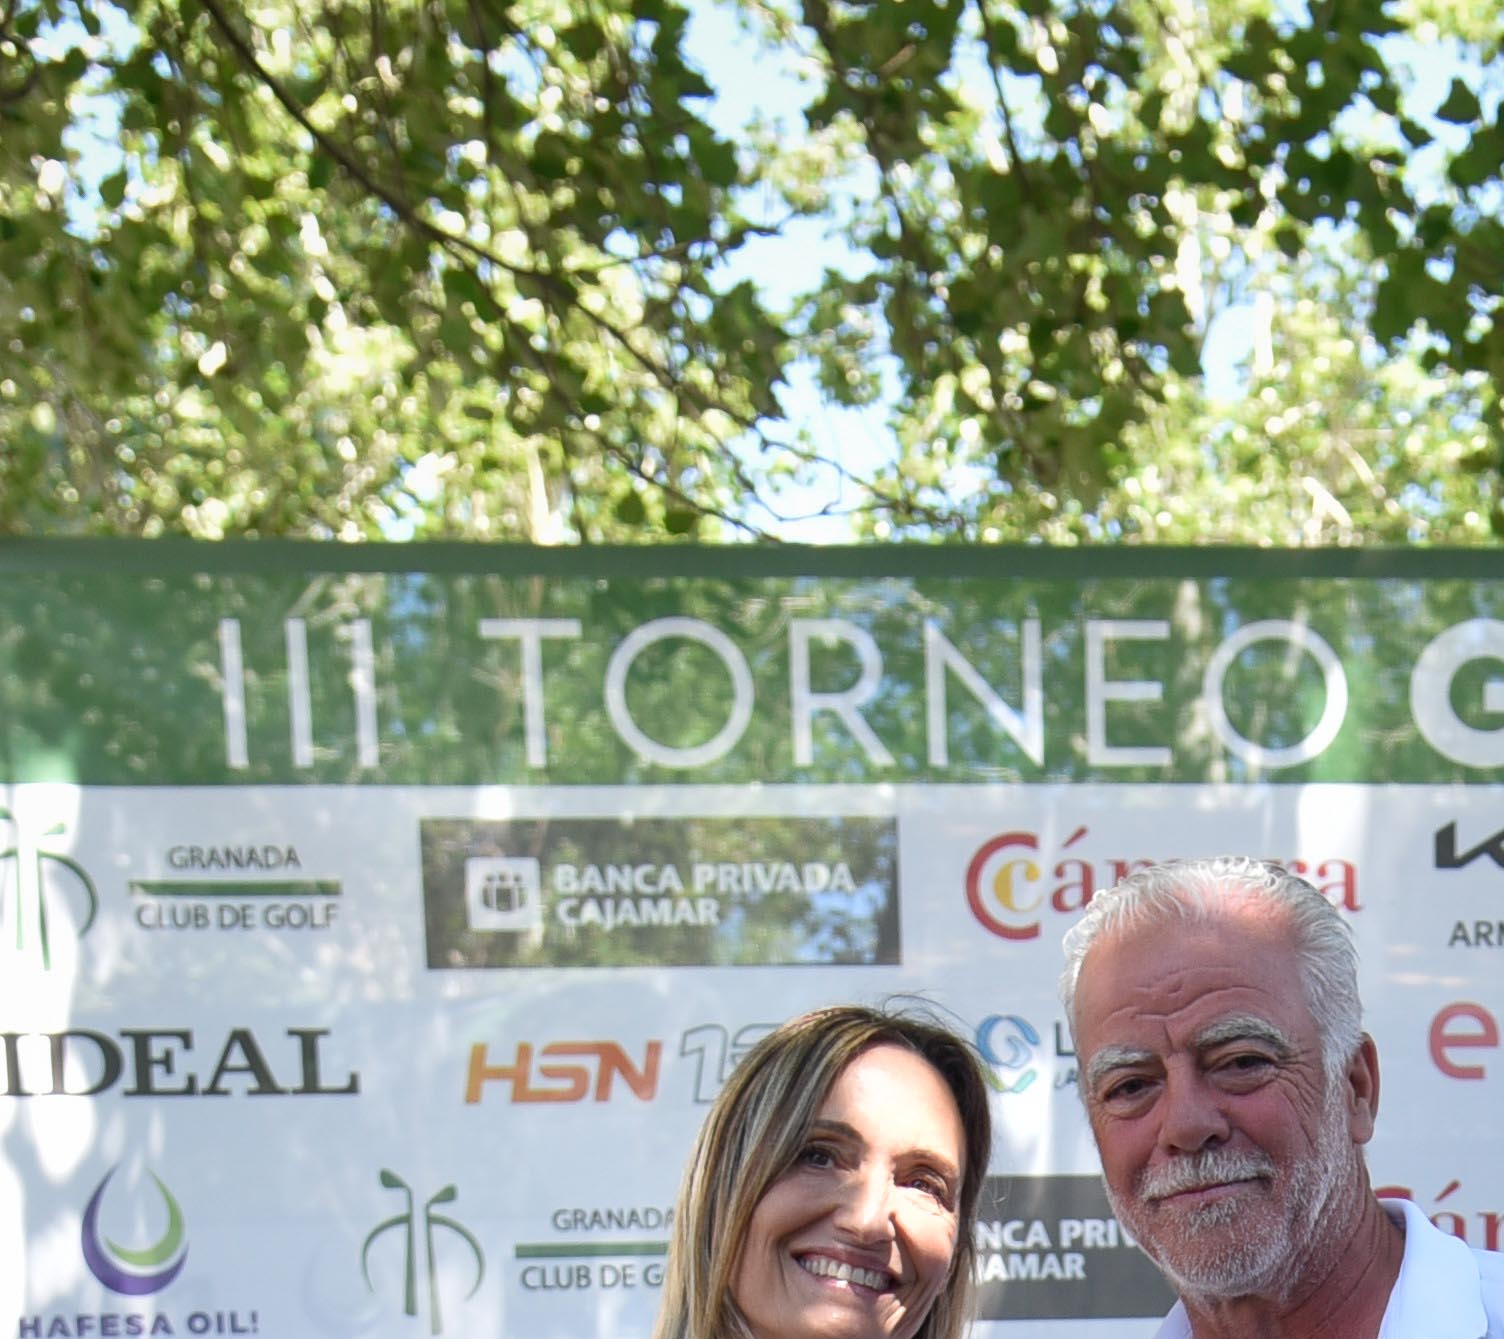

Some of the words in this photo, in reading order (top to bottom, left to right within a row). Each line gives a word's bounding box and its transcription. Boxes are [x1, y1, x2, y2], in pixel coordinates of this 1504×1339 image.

[219, 617, 380, 769] III
[478, 616, 1348, 771] TORNEO
[167, 844, 300, 872] GRANADA
[553, 861, 682, 894] BANCA
[694, 859, 856, 893] PRIVADA
[134, 902, 213, 933] CLUB
[218, 902, 254, 932] DE
[259, 901, 340, 931] GOLF
[555, 895, 722, 931] CAJAMAR
[464, 1040, 663, 1104] HSN
[520, 1265, 592, 1291] CLUB
[600, 1264, 635, 1289] DE
[18, 1313, 173, 1339] HAFESA
[187, 1310, 260, 1336] OIL!
